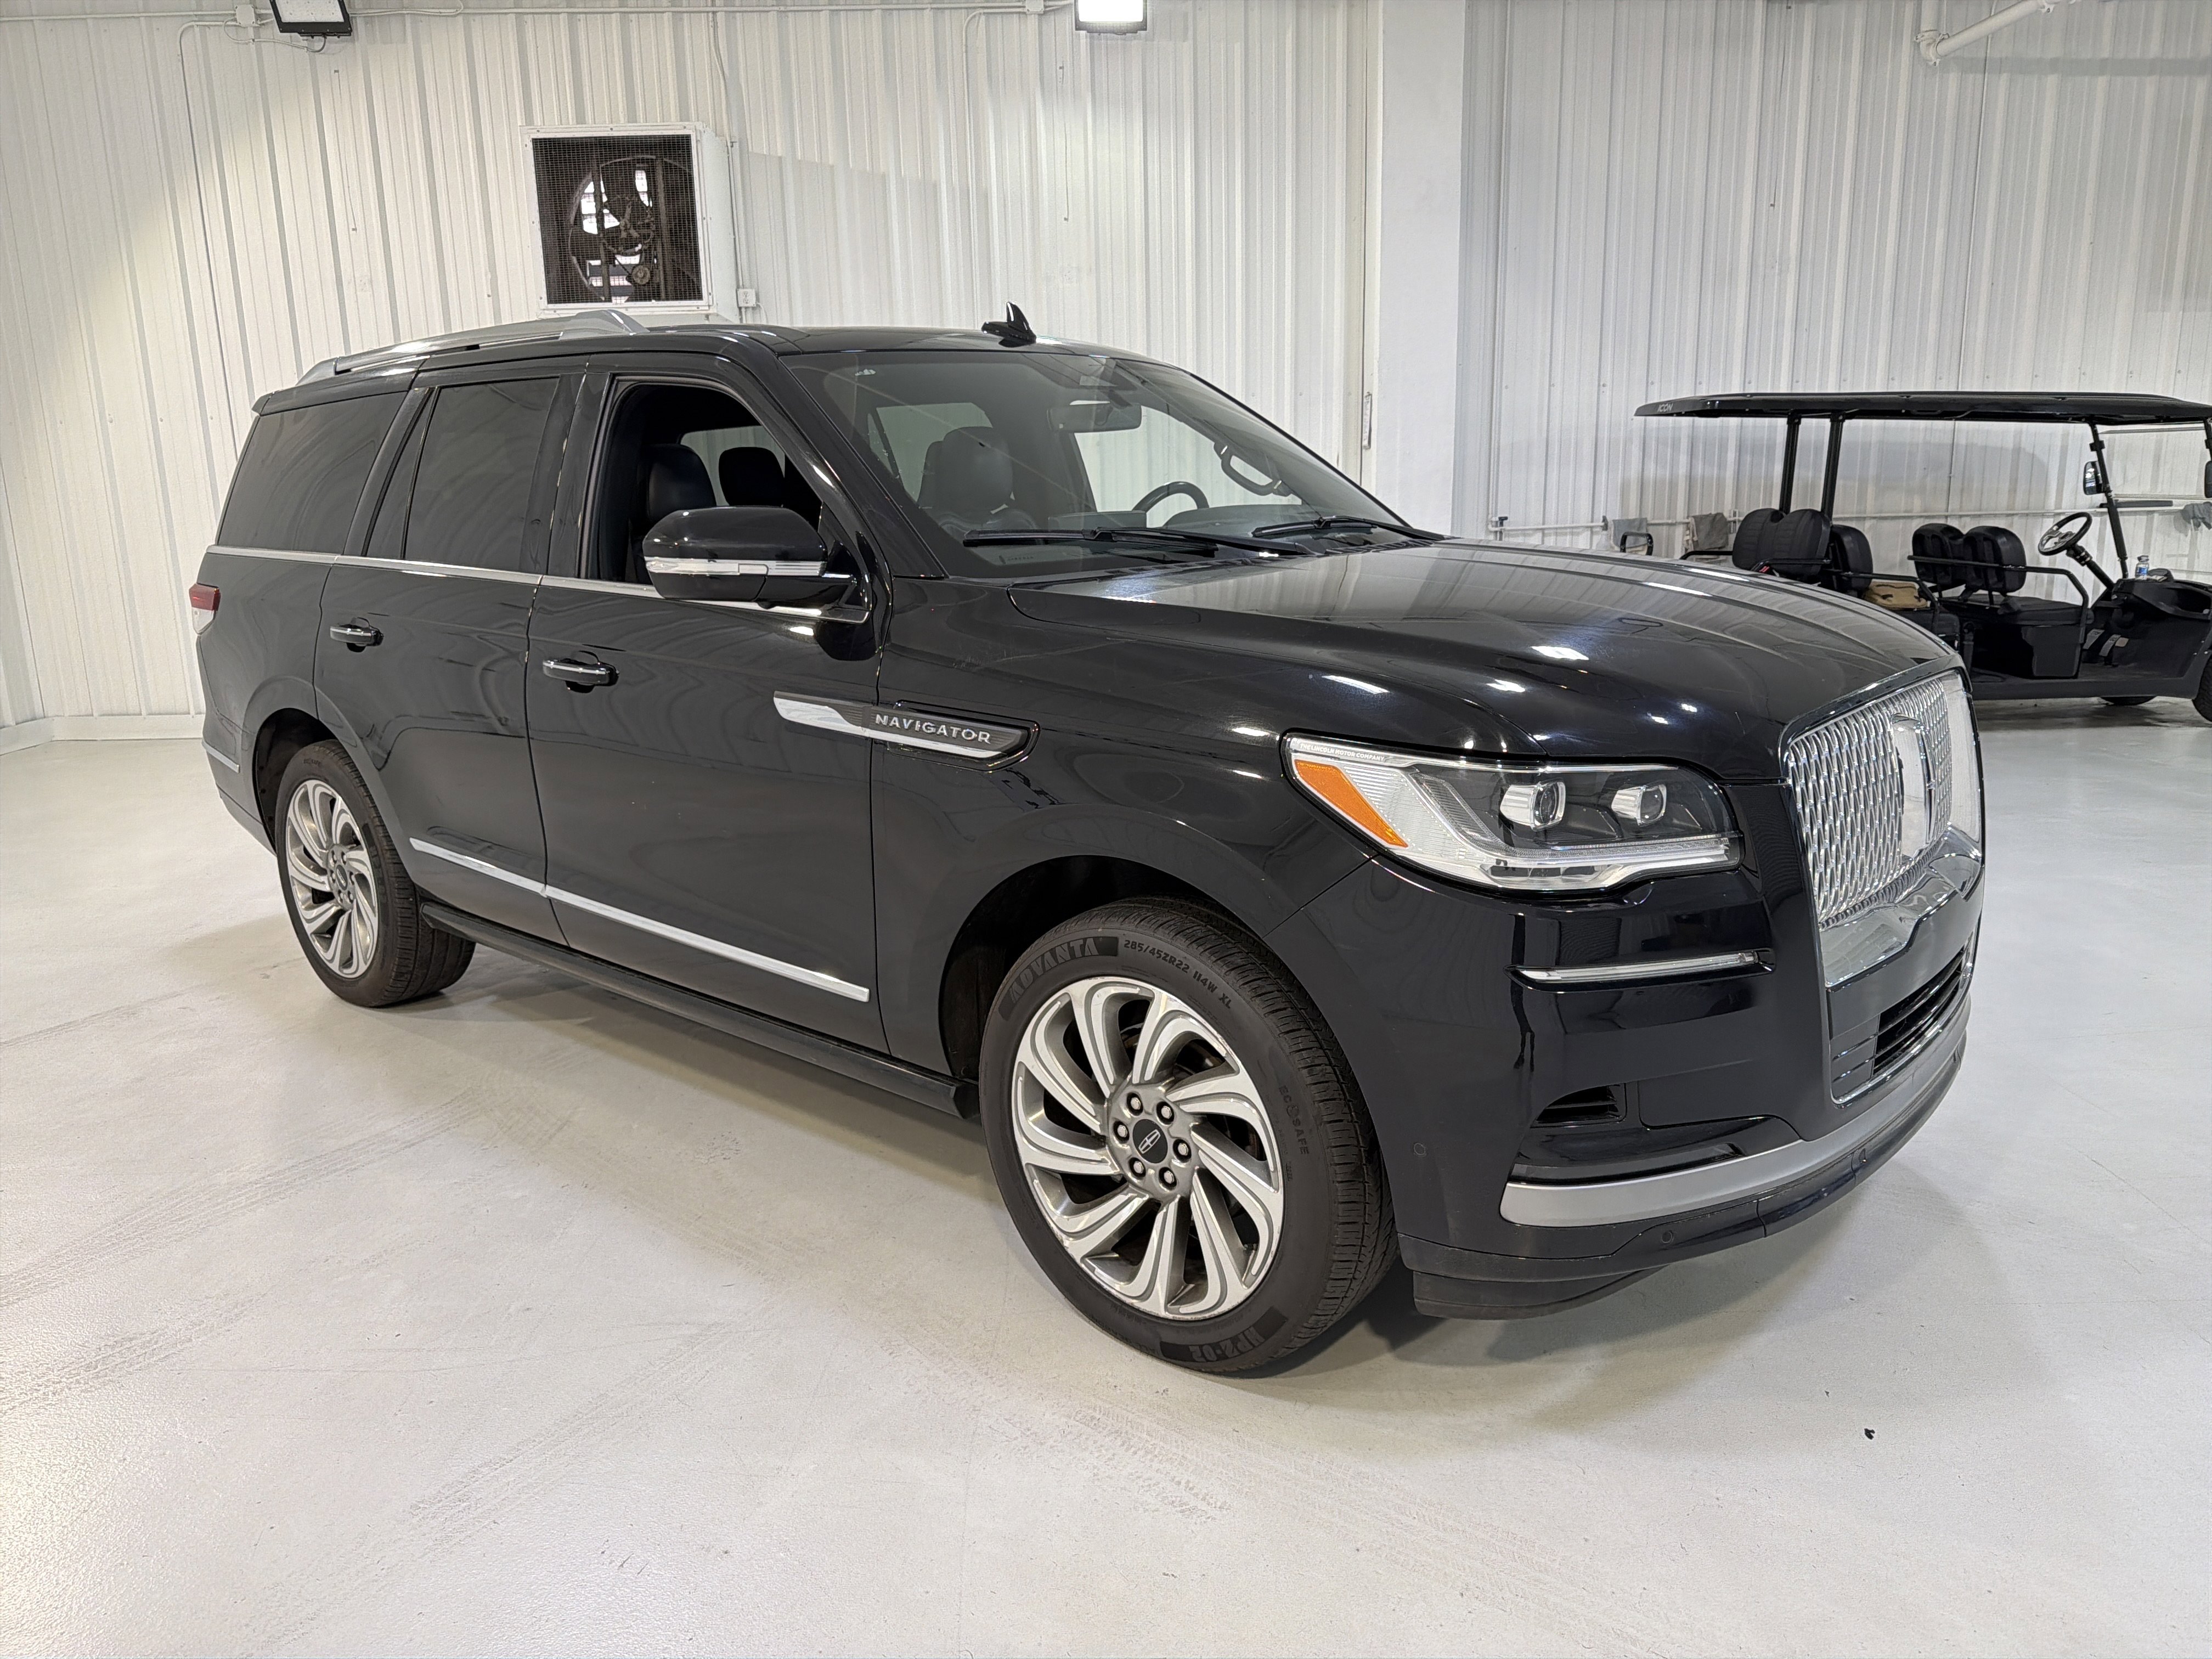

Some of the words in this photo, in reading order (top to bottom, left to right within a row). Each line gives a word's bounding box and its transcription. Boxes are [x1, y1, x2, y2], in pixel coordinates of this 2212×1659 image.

[1657, 403, 1673, 413] ICON
[876, 714, 991, 744] NAVIGATOR
[1311, 745, 1335, 754] LINCOLN
[1335, 748, 1356, 758] MOTOR
[1356, 752, 1385, 761] COMPANY
[1009, 938, 1099, 1003] ADVANTA
[1124, 940, 1190, 973] 285/45ZR22
[1193, 970, 1218, 994] 114W
[1218, 993, 1232, 1009] XL
[1188, 1326, 1266, 1363] HPZ-02
